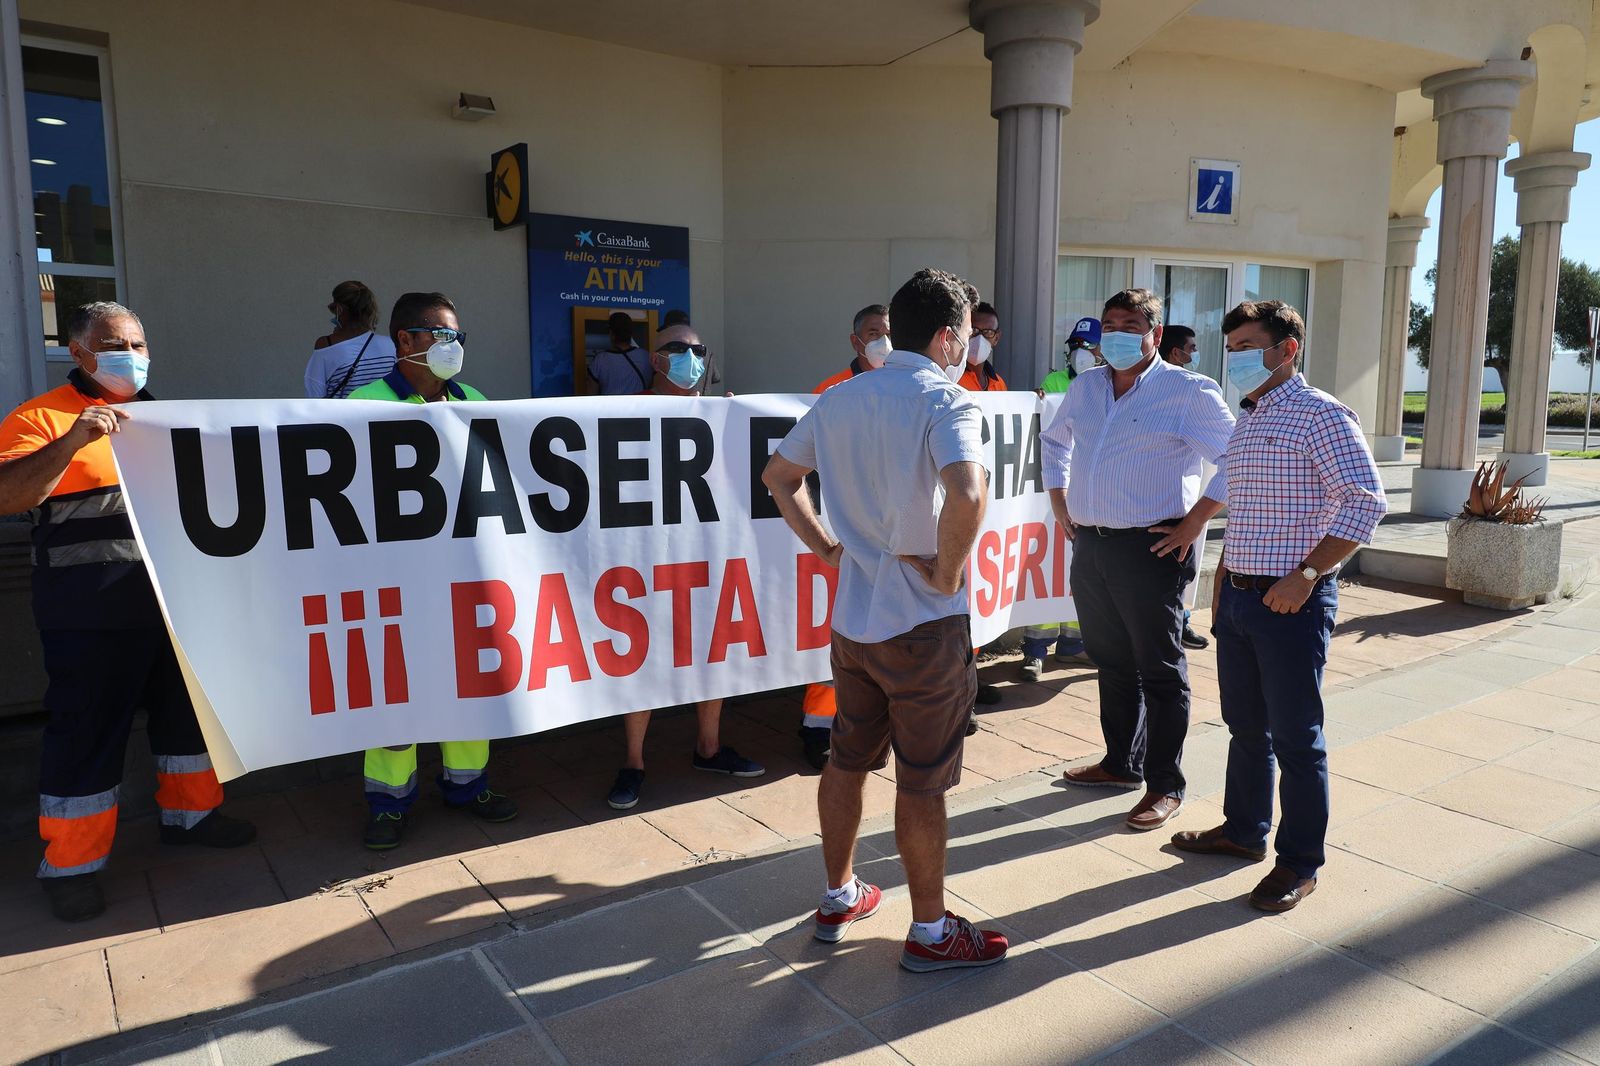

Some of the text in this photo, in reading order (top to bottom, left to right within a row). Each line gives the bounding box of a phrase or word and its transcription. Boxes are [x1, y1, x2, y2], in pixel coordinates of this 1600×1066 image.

[597, 232, 651, 249] CaixaBank
[564, 250, 663, 269] Hello, this is your
[583, 267, 644, 293] ATM
[560, 292, 580, 301] Cash
[581, 293, 590, 302] in
[591, 295, 610, 303] your
[630, 296, 665, 306] language
[170, 416, 720, 557] URBASER
[981, 413, 1045, 500] HA
[450, 557, 767, 699] BASTA
[796, 552, 841, 651] D
[967, 521, 1074, 618] SERI
